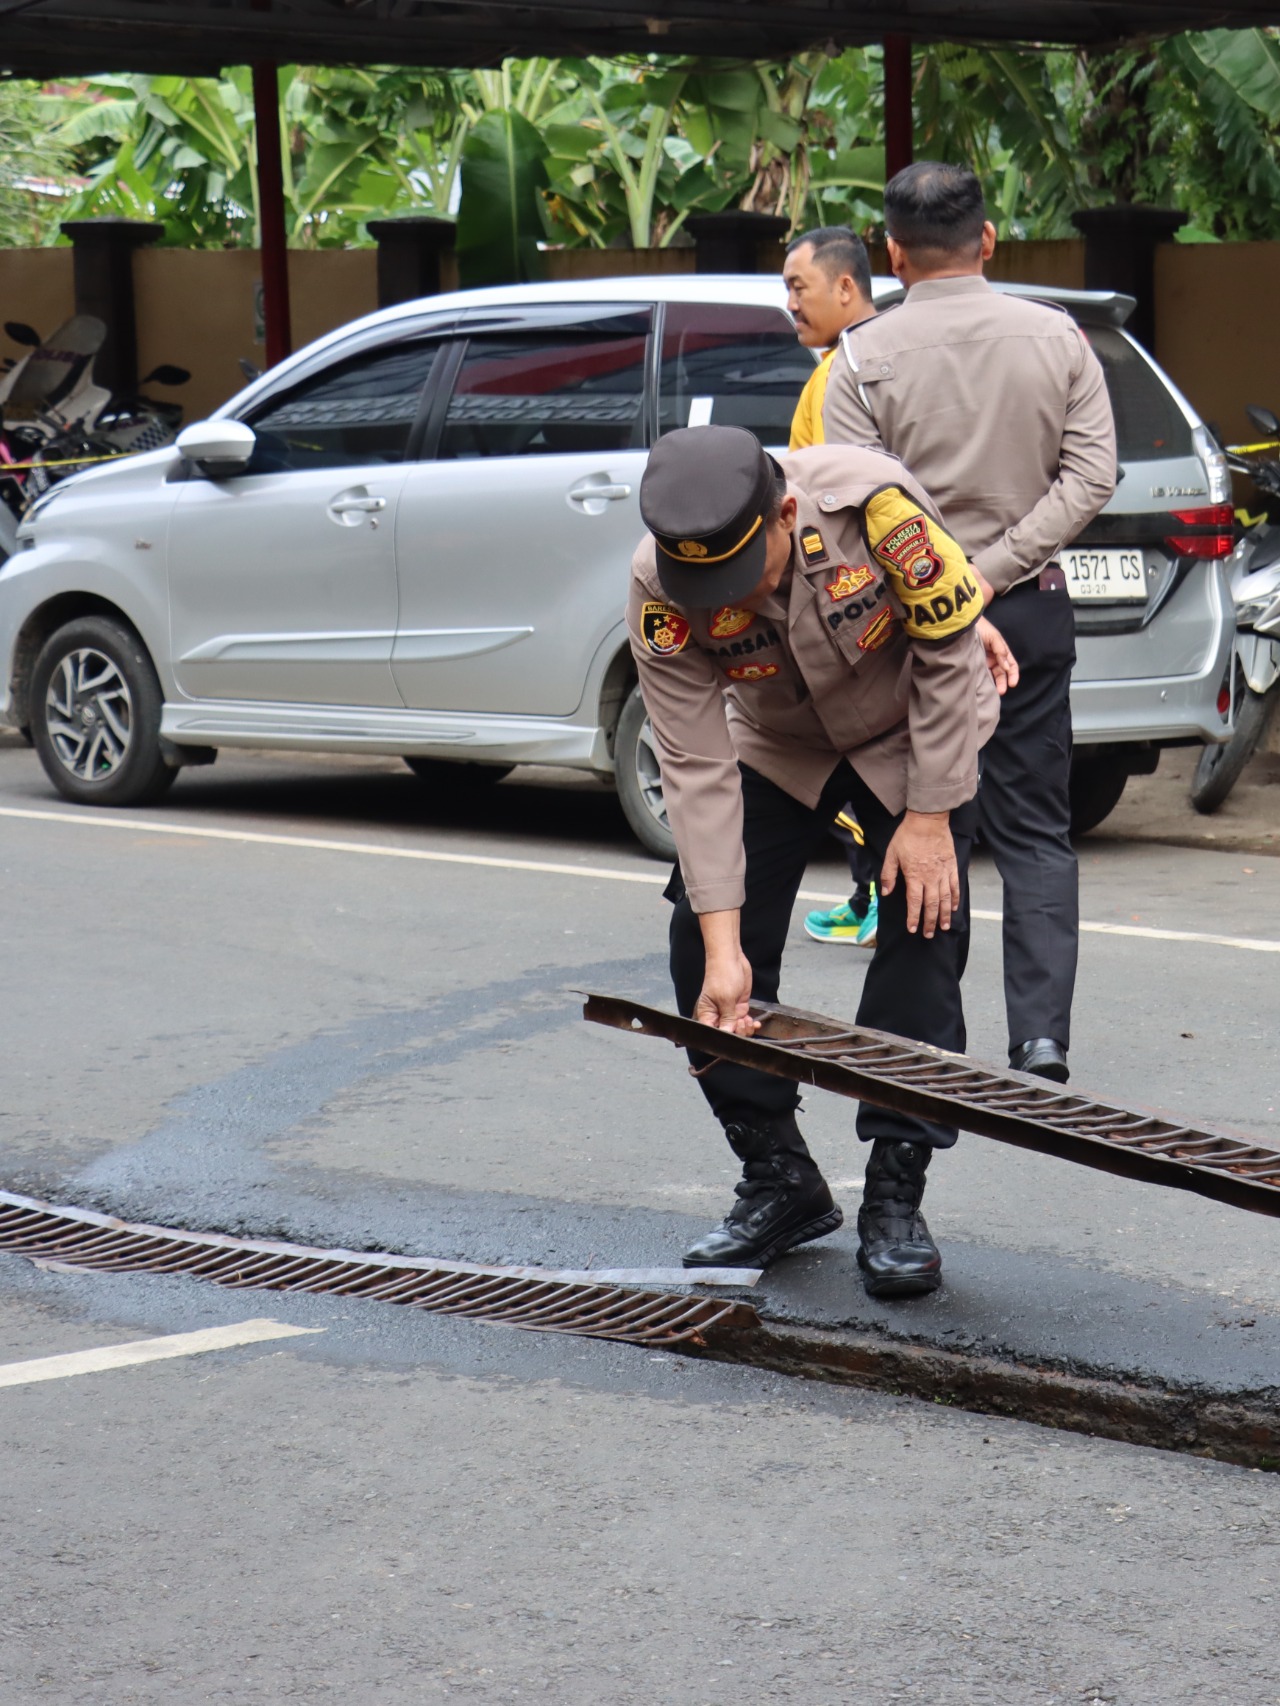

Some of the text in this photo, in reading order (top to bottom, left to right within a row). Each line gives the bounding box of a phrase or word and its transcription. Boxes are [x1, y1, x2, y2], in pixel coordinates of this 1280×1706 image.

[885, 523, 918, 549] POLRESTA
[1070, 555, 1140, 580] 1571 CS
